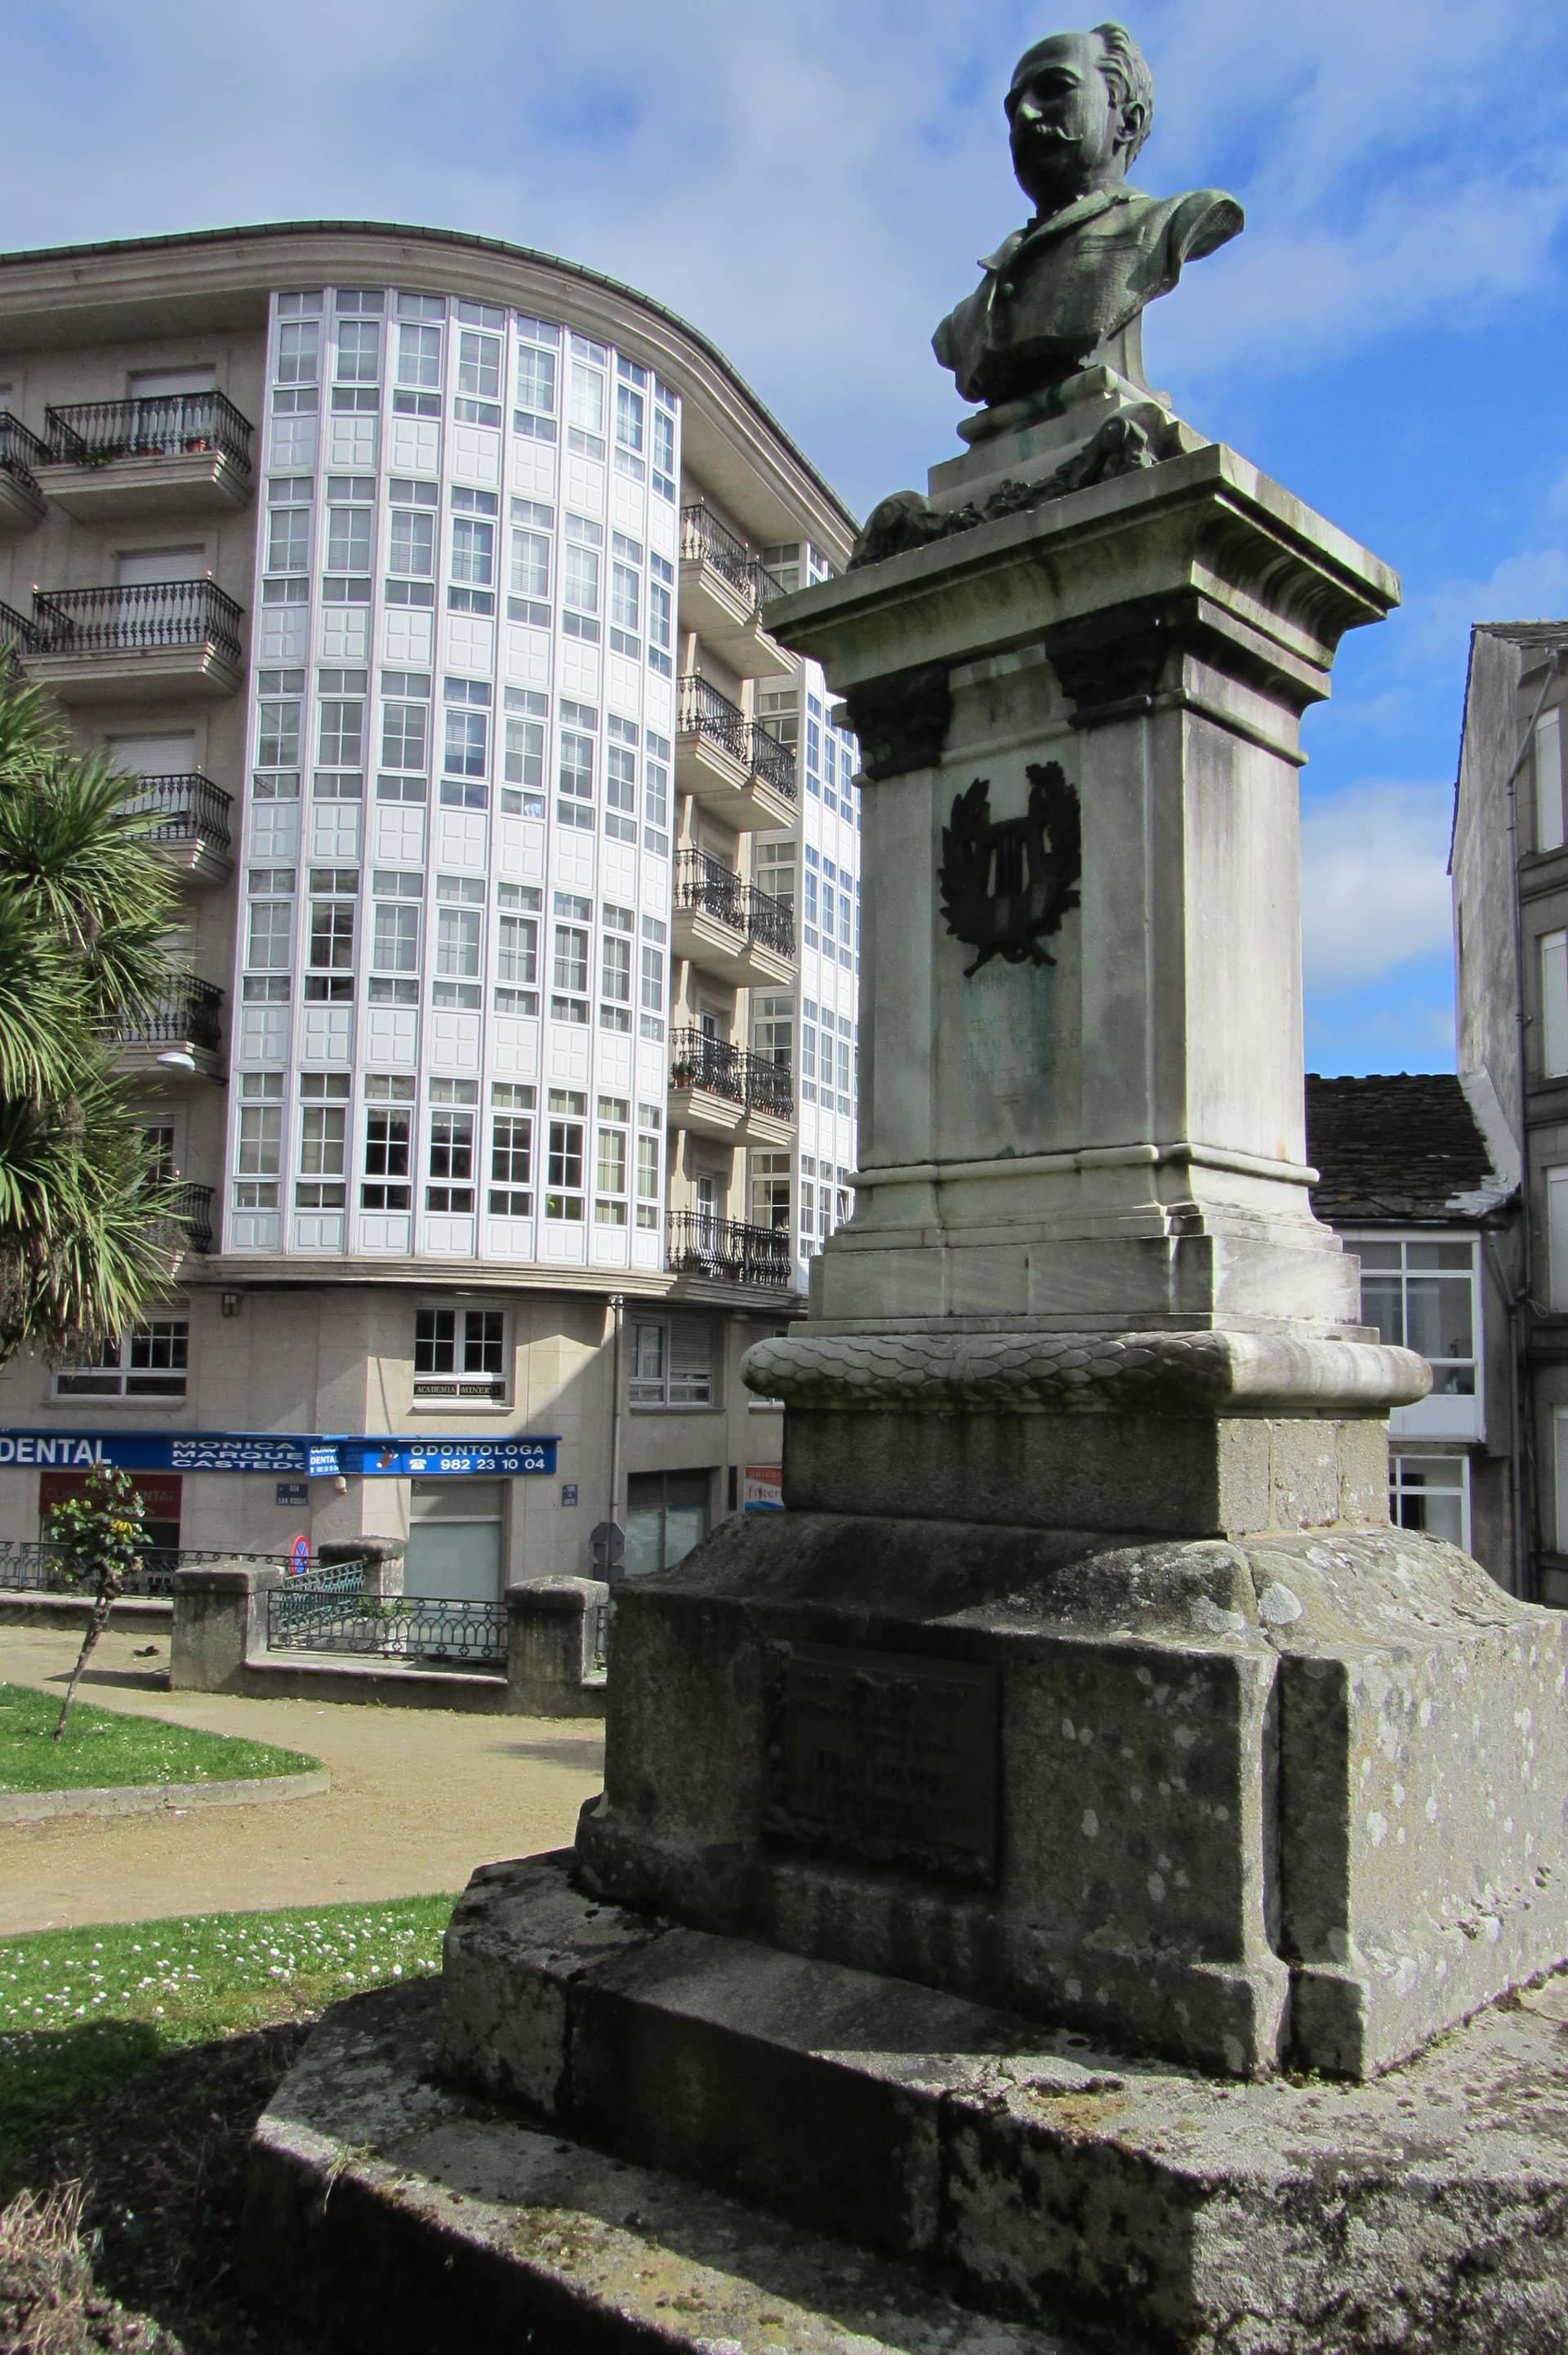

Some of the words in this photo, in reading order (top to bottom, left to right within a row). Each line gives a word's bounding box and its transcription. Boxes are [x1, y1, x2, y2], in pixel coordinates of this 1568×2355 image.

[416, 1385, 456, 1394] ACADEMIA
[461, 1385, 499, 1394] MINER
[0, 1437, 112, 1465] DENTAL
[172, 1441, 296, 1451] MONICA
[411, 1445, 545, 1456] ODONTOLOGA
[310, 1455, 339, 1465] DENTAL
[440, 1459, 471, 1470] 982
[476, 1459, 496, 1470] 23
[502, 1459, 519, 1470] 10
[524, 1459, 546, 1470] 04
